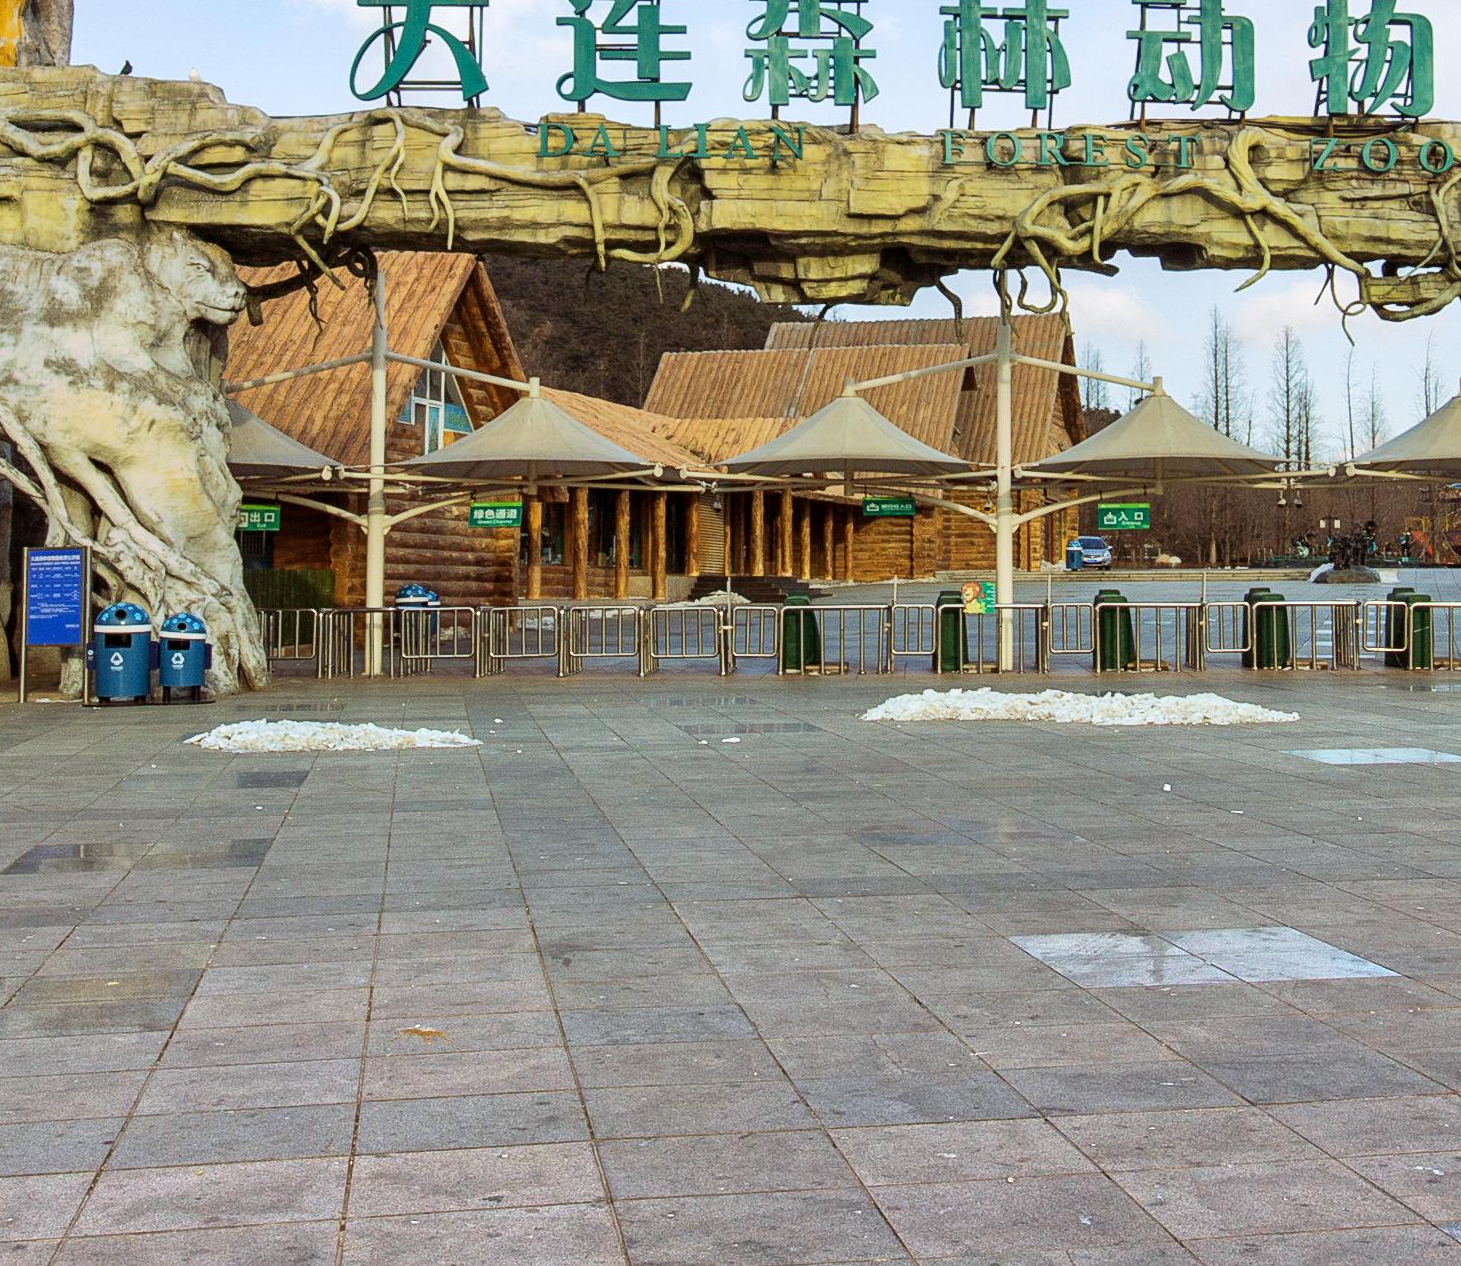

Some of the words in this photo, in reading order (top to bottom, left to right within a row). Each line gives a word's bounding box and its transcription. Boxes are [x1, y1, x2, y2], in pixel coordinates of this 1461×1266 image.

[939, 131, 1199, 168] FOREST
[1310, 137, 1454, 173] ZOO
[250, 511, 275, 523] 出口
[1118, 511, 1144, 521] 入口
